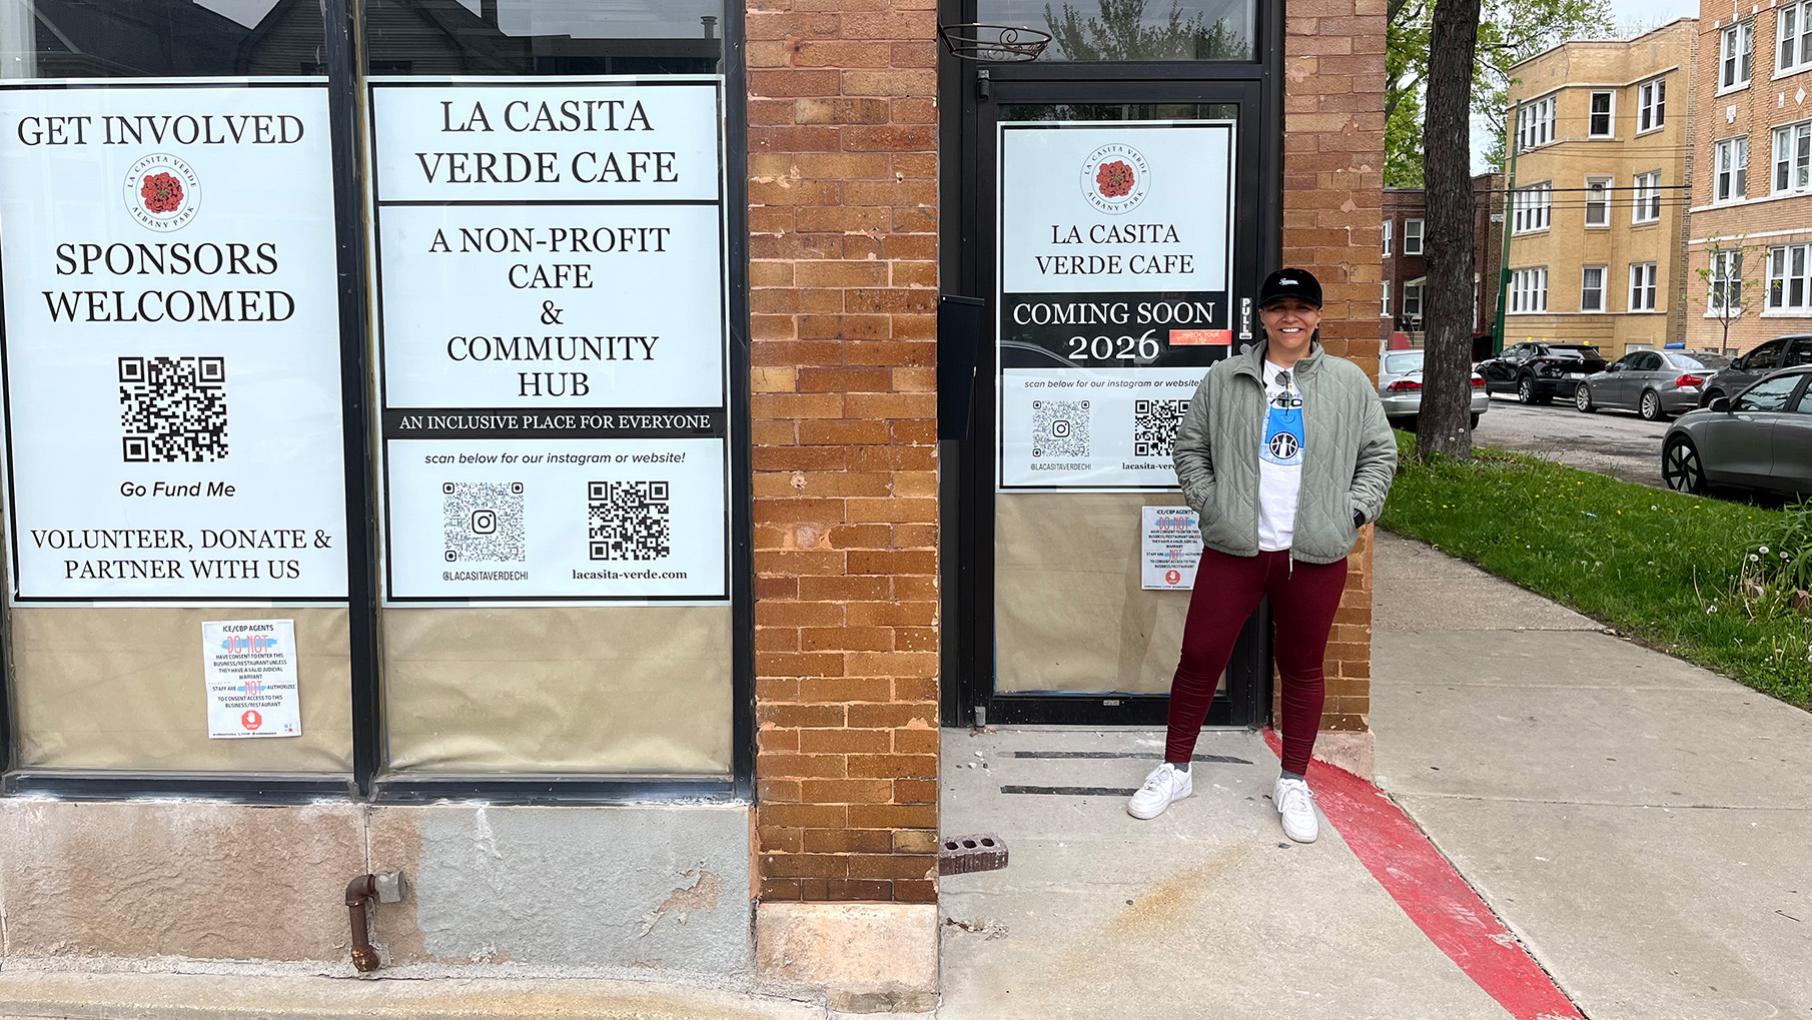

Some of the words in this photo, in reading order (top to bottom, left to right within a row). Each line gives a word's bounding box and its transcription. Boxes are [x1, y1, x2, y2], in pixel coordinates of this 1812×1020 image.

[440, 101, 494, 132] LA
[504, 100, 654, 132] CASITA
[18, 116, 91, 145] GET
[102, 115, 304, 144] INVOLVED
[1092, 146, 1124, 161] CASITA
[127, 176, 136, 188] LA
[135, 156, 168, 173] CASITA
[173, 160, 196, 187] VERDE
[415, 152, 560, 183] VERDE
[572, 152, 678, 183] CAFE
[132, 207, 169, 228] ALBANY
[174, 206, 194, 226] PARK
[429, 228, 451, 252] A
[459, 227, 670, 252] NON-PROFIT
[1052, 225, 1083, 244] LA
[1090, 224, 1180, 243] CASITA
[56, 243, 277, 275] SPONSORS
[1035, 255, 1122, 274] VERDE
[1130, 255, 1194, 274] CAFE
[509, 264, 593, 289] CAFE
[41, 290, 295, 322] WELCOMED
[541, 300, 563, 325] &
[1014, 303, 1130, 325] COMING
[1137, 302, 1215, 324] SOON
[1242, 297, 1251, 333] PULL
[447, 336, 659, 361] COMMUNITY
[1068, 329, 1160, 360] 2026
[518, 372, 589, 396] HUB
[1048, 380, 1074, 388] below
[1107, 380, 1151, 389] instagram
[400, 416, 423, 429] AN
[427, 416, 518, 429] INCLUSIVE
[523, 415, 576, 429] PLACE
[580, 415, 615, 429] FOR
[618, 415, 710, 428] EVERYONE
[425, 456, 455, 464] scan
[459, 453, 498, 464] below
[501, 453, 519, 463] for
[522, 455, 543, 463] our
[547, 453, 611, 466] instagram
[615, 455, 628, 463] or
[632, 452, 685, 463] website!
[1031, 463, 1091, 471] @LACASITAVERDECHI
[121, 482, 146, 497] Go
[153, 482, 201, 497] Fund
[207, 482, 235, 497] Me
[31, 530, 193, 552] VOLUNTEER,
[201, 530, 307, 549] DONATE
[314, 529, 331, 548] &
[64, 560, 184, 579] PARTNER
[190, 560, 259, 578] WITH
[268, 560, 299, 579] US
[443, 571, 528, 581] @LACASITAVERDECHI
[573, 569, 687, 579] lacasita-verde.com
[248, 624, 274, 632] AGENTS
[227, 635, 241, 654] DO
[246, 634, 269, 653] NOT
[244, 680, 262, 696] NOT
